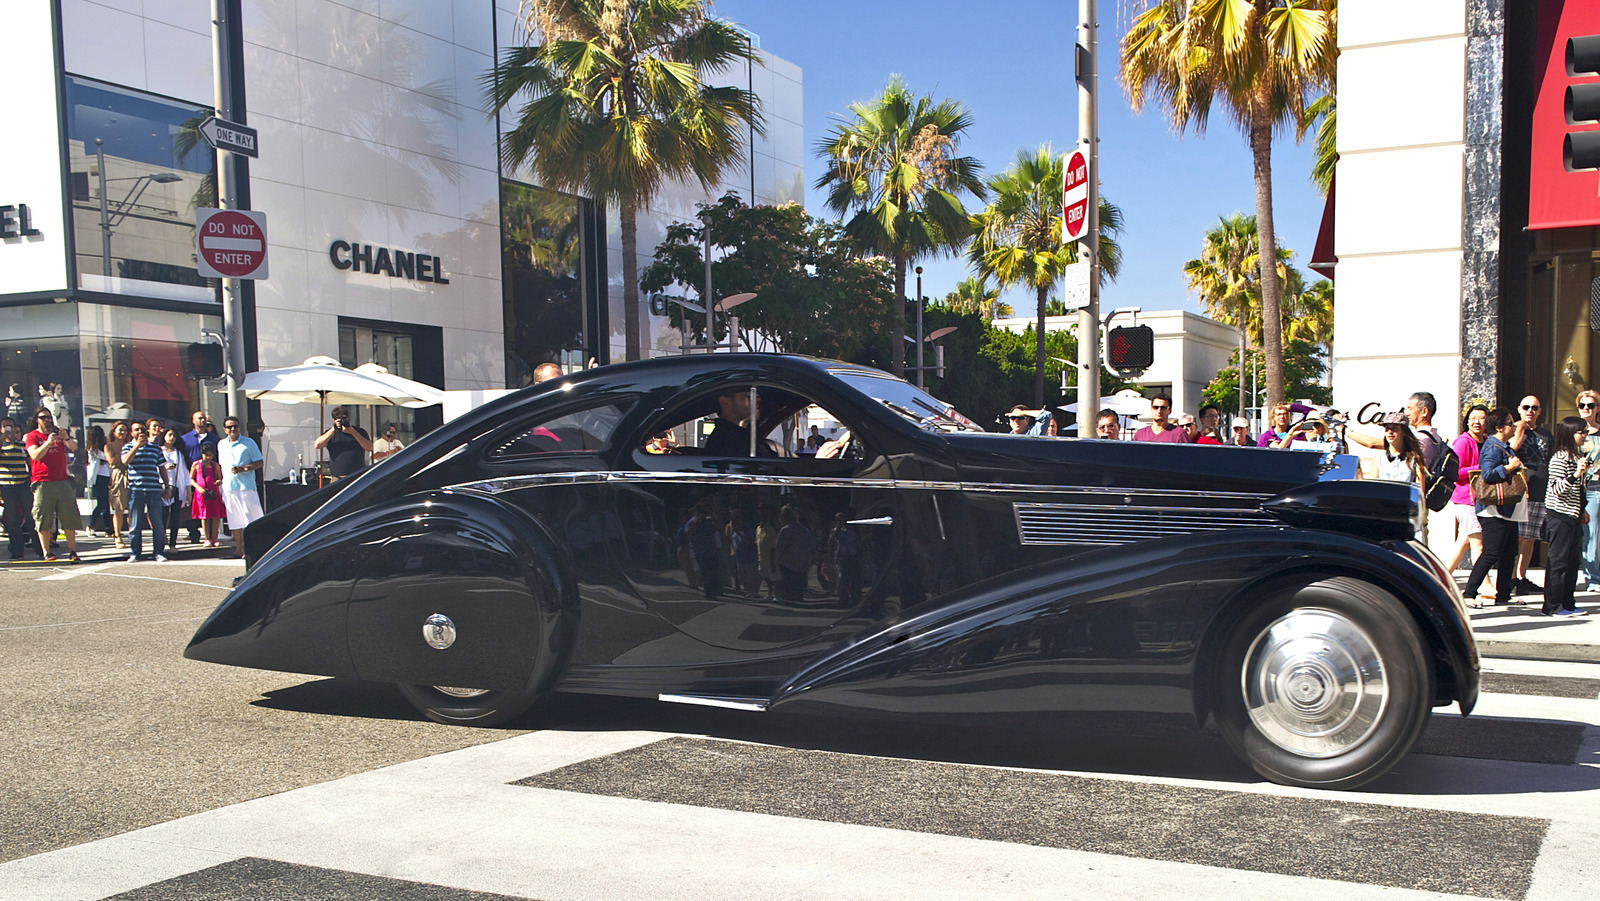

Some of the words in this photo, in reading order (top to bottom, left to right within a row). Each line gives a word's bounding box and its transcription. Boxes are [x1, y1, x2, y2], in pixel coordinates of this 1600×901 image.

[216, 128, 233, 142] ONE
[234, 133, 252, 147] WAY
[1066, 170, 1075, 187] DO
[1075, 164, 1086, 182] NOT
[1068, 204, 1084, 224] ENTER
[208, 222, 226, 234] DO
[232, 223, 255, 236] NOT
[214, 252, 252, 265] ENTER
[330, 240, 449, 285] CHANEL
